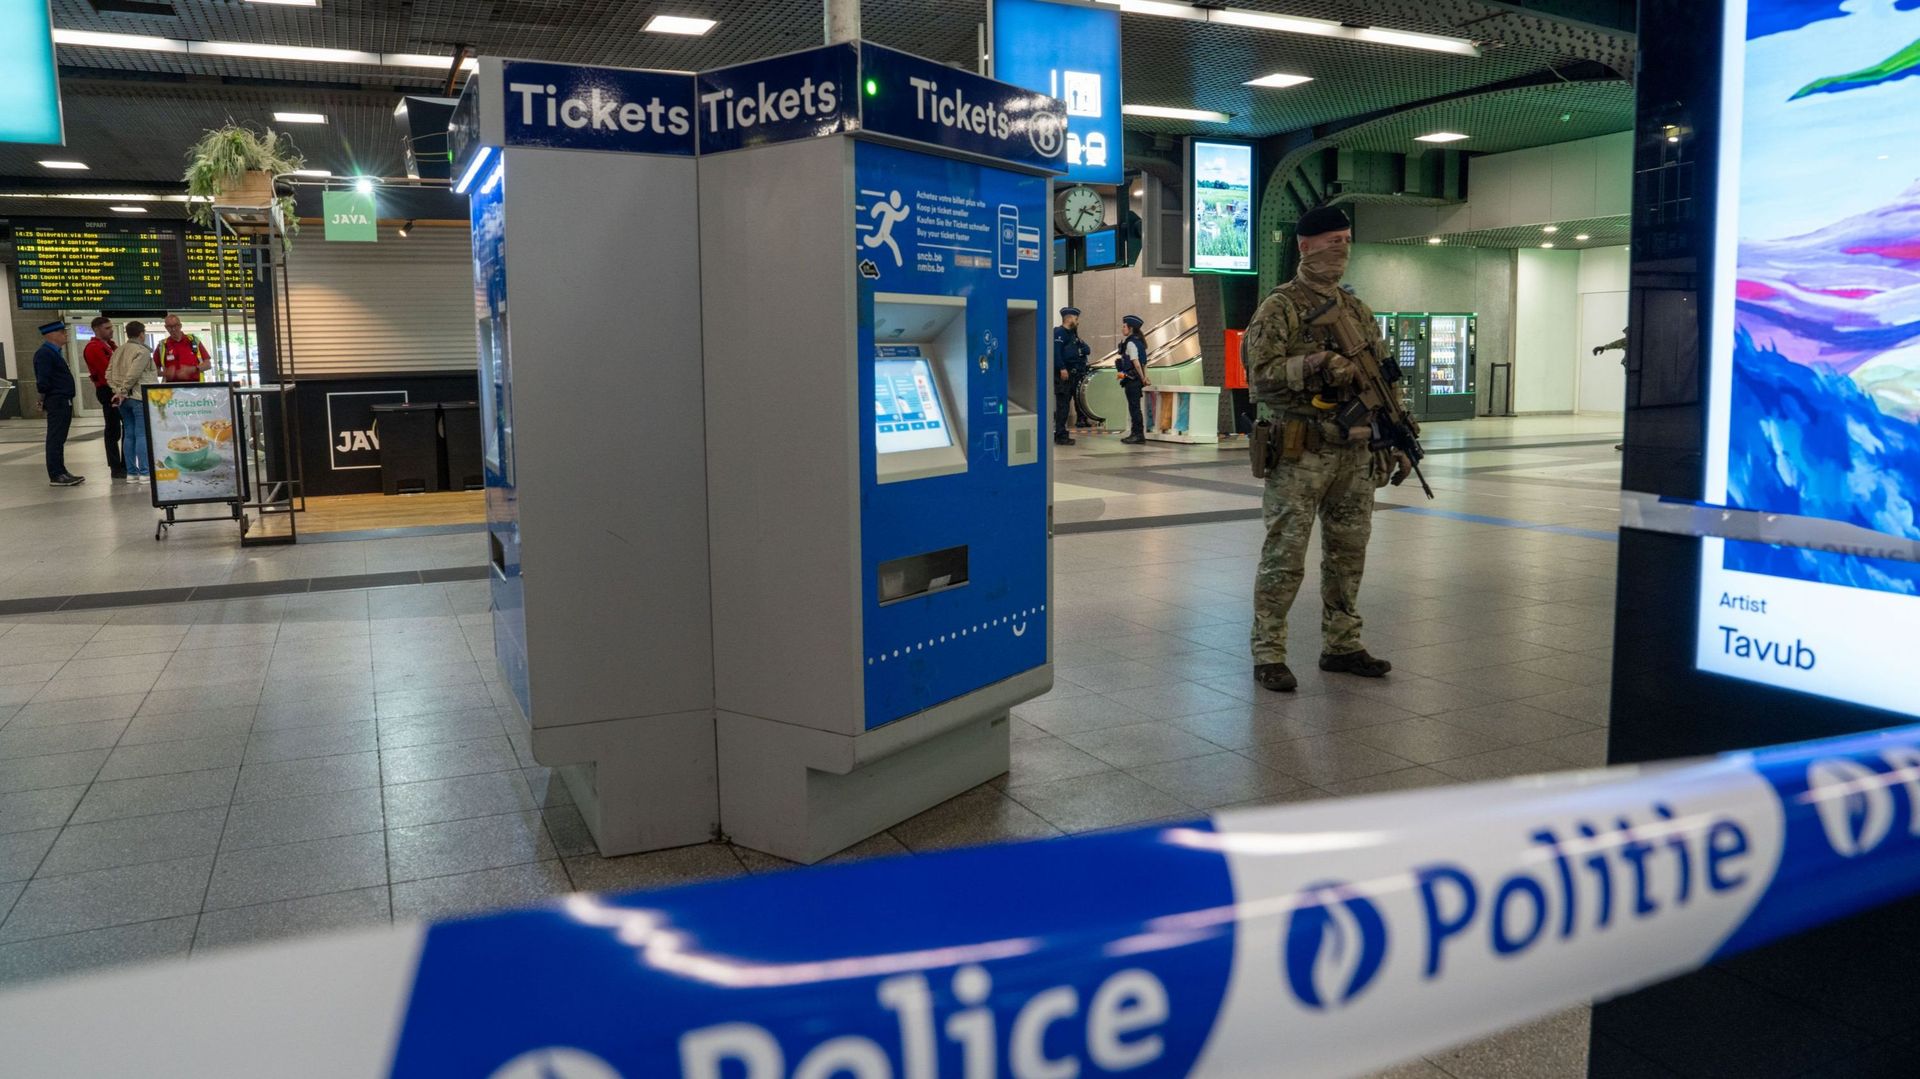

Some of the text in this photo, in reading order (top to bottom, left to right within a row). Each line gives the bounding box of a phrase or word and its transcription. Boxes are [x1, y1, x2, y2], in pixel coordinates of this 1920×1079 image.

[510, 82, 690, 136] Tickets
[701, 77, 837, 133] Tickets
[909, 76, 1009, 141] Tickets
[916, 190, 986, 208] Achetez votre billet plus vite
[331, 214, 368, 225] JAVA
[916, 203, 969, 217] Koop je ticket sneller
[916, 216, 936, 226] Kaufen
[936, 217, 944, 226] Sie
[953, 220, 968, 230] Ticket
[969, 222, 990, 232] schneller
[916, 228, 970, 241] Buy your ticket faster
[917, 251, 942, 262] sncb.be
[917, 262, 945, 273] nmbs.be
[336, 430, 380, 453] JAV
[1719, 592, 1767, 614] Artist
[1718, 625, 1816, 670] Tavub
[1411, 803, 1751, 981] Politie
